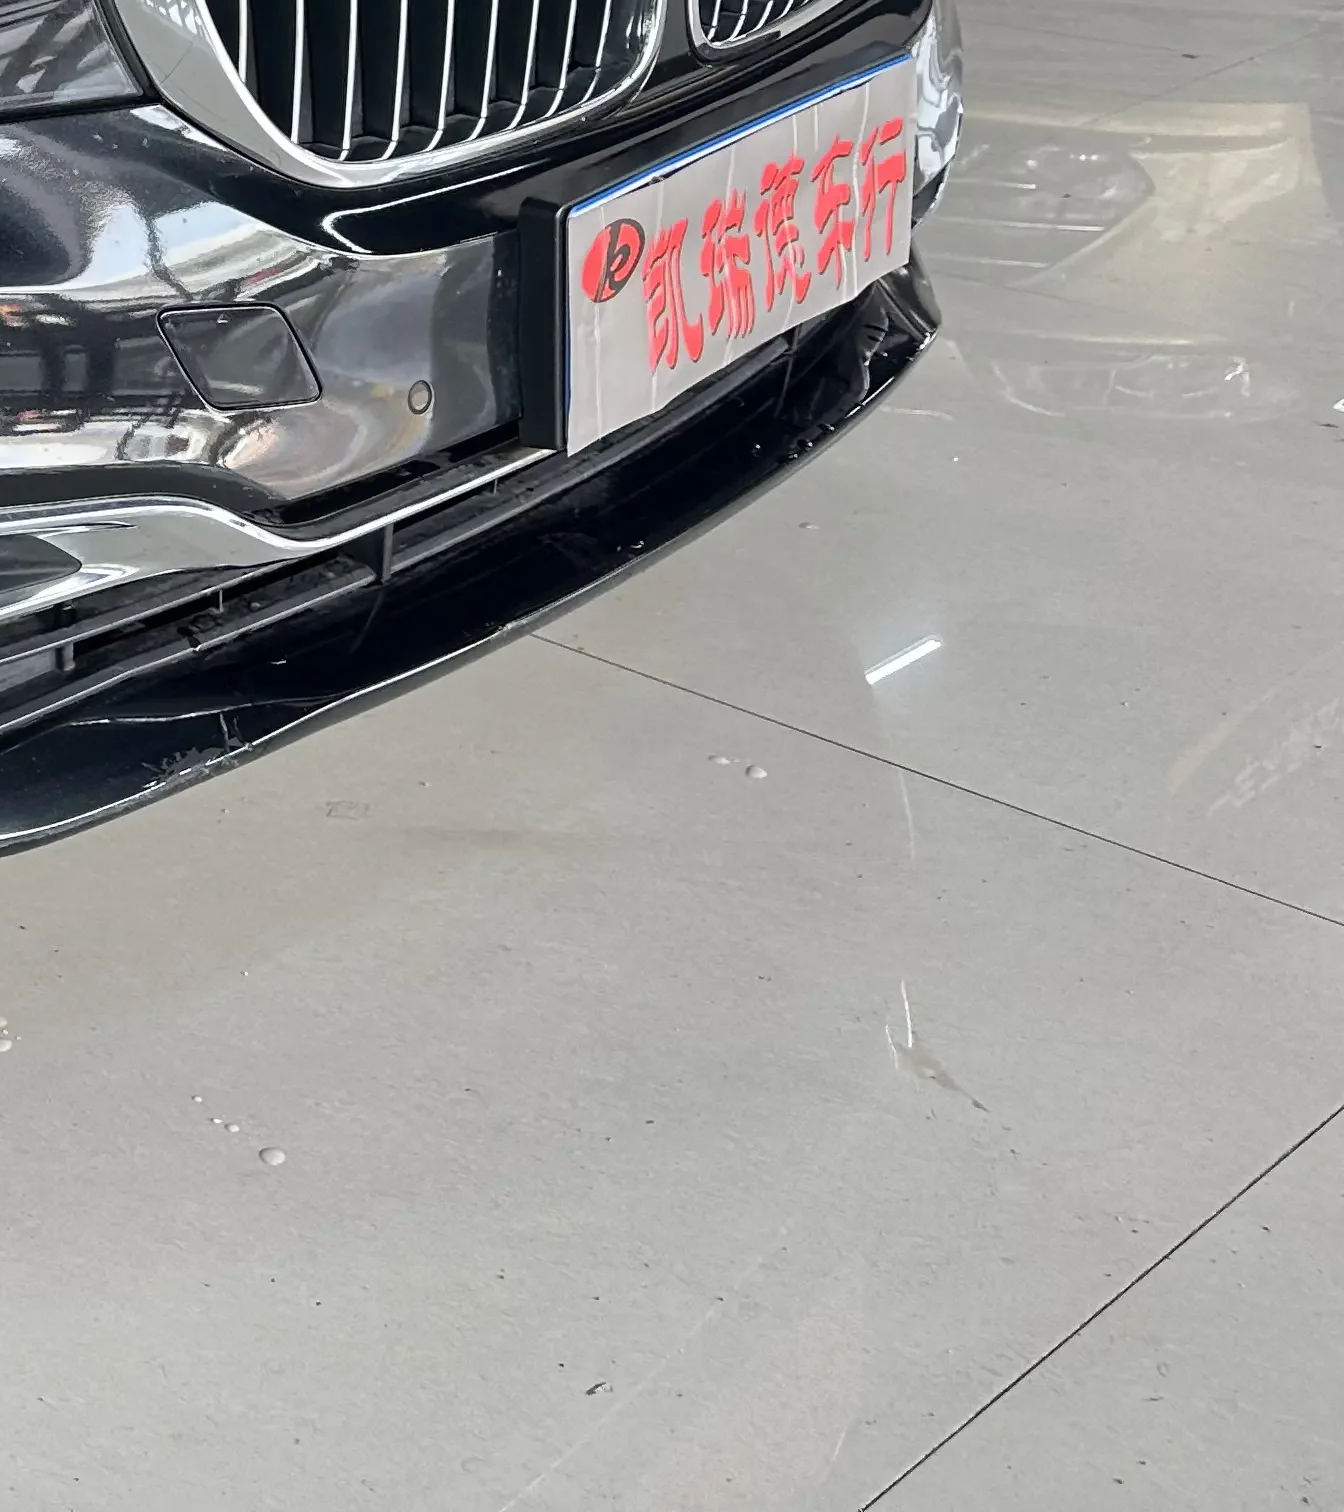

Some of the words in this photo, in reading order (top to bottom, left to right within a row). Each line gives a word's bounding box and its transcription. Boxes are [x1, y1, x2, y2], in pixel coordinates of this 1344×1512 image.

[641, 116, 908, 375] 凯瑞德车行
